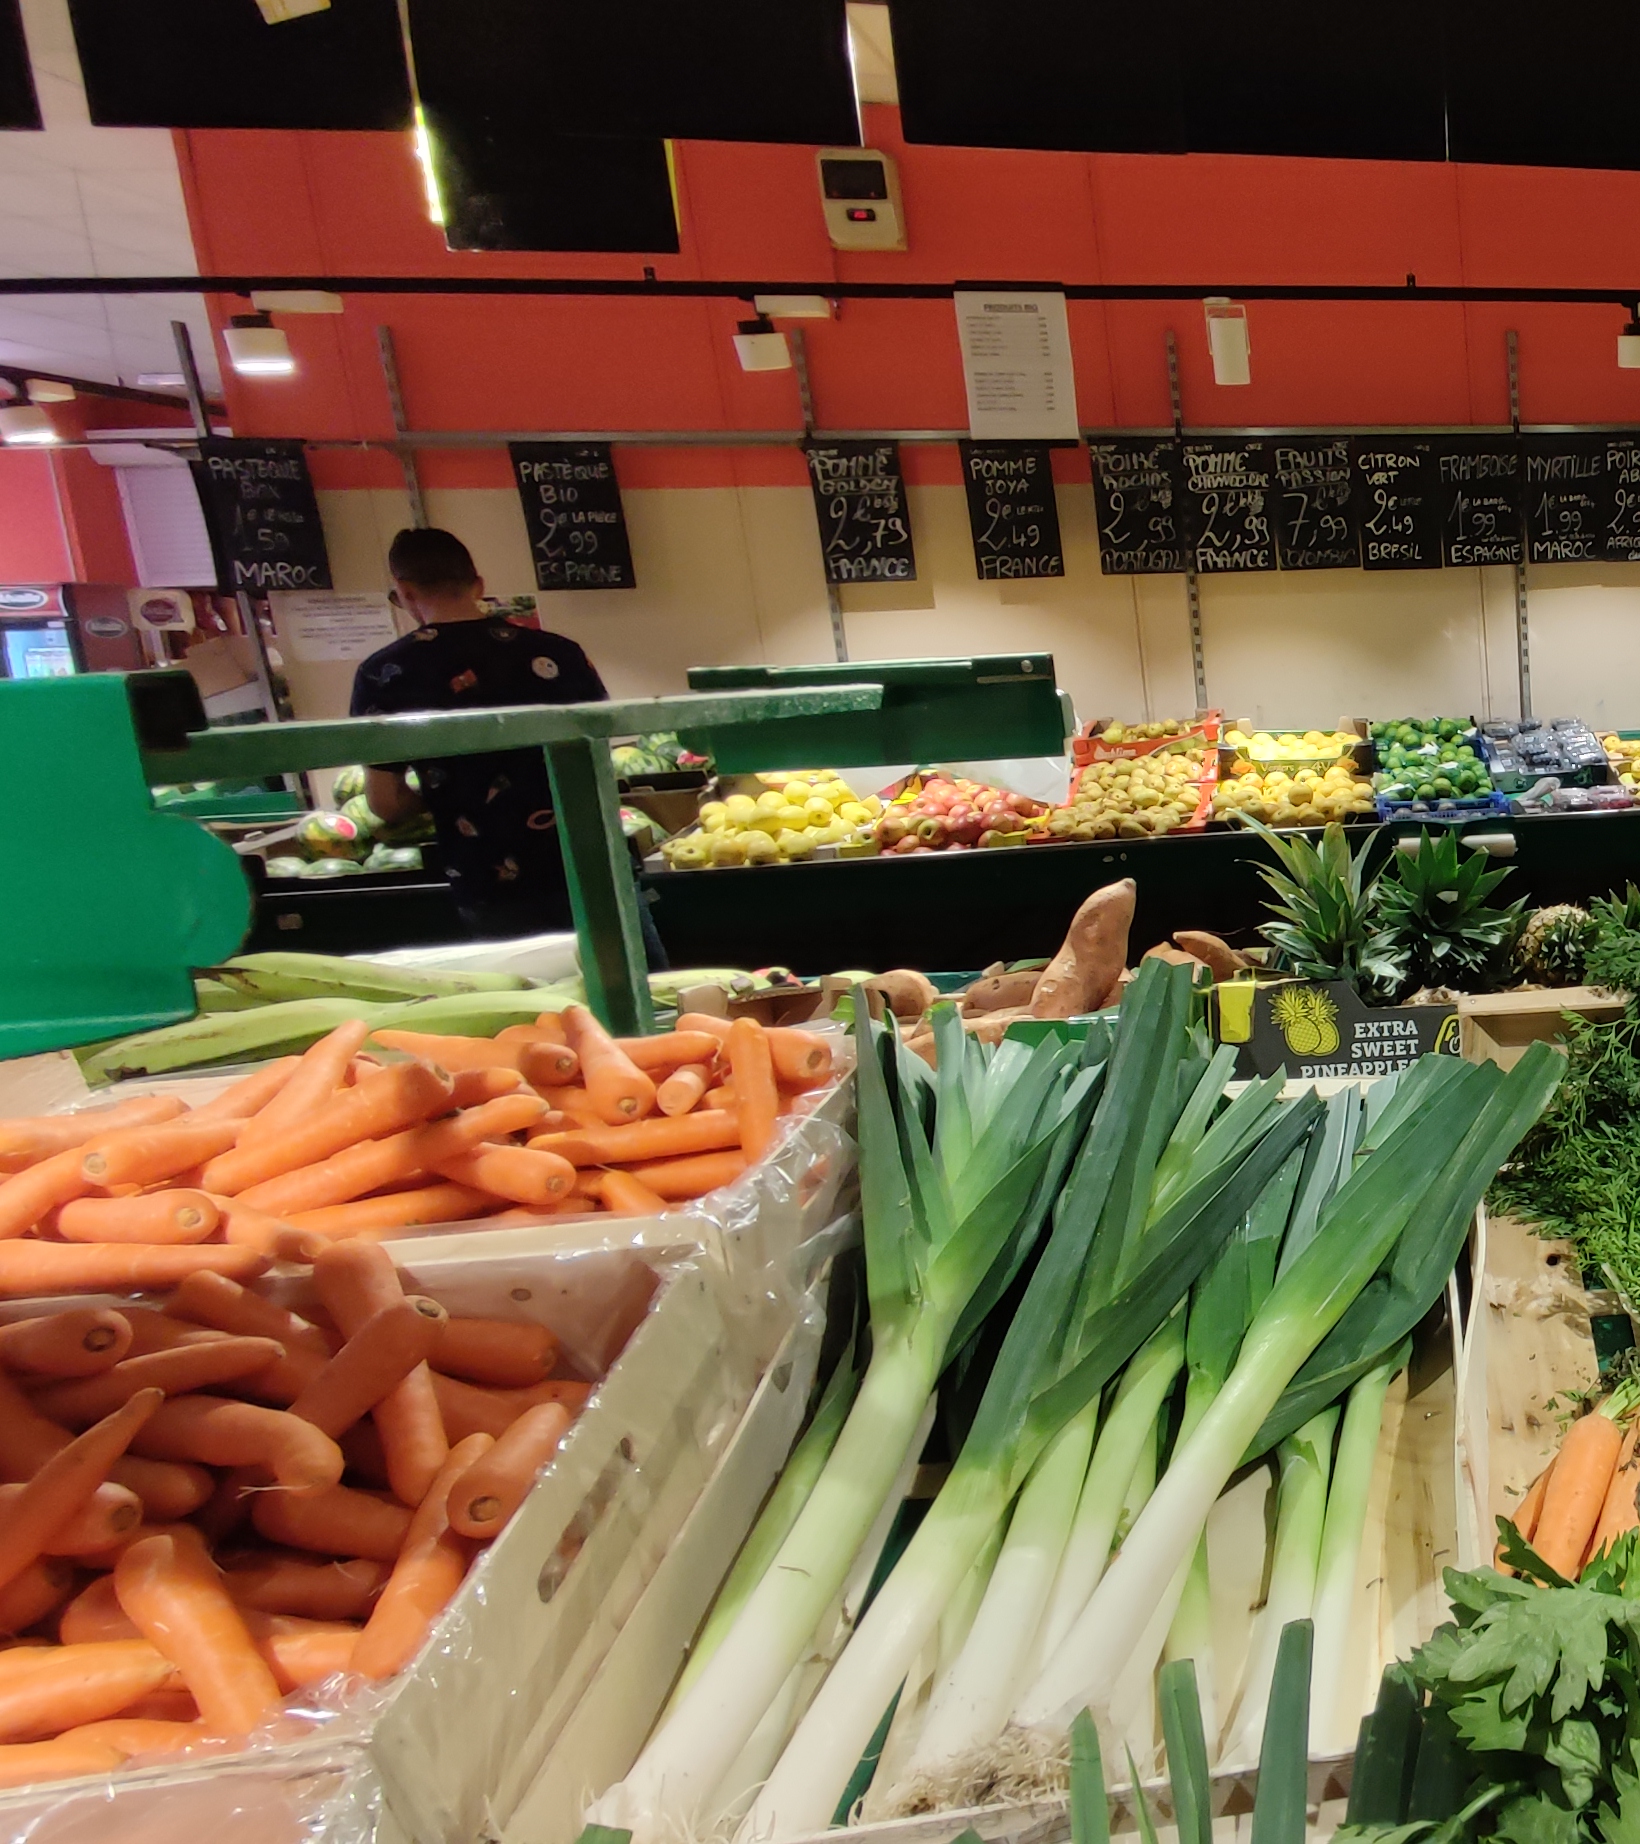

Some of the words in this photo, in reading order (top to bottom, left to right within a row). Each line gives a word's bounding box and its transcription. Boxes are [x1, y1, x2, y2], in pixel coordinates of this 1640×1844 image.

[983, 303, 1022, 312] PRODUITS
[809, 455, 887, 480] POMME
[969, 457, 1037, 480] POMME
[1183, 451, 1250, 477] POMME
[1357, 451, 1420, 470] CITRON
[1527, 454, 1601, 483] MYRTILLE
[985, 478, 1030, 496] JOYA
[1365, 471, 1400, 485] VERT
[1195, 548, 1269, 573] FRANCE
[1368, 542, 1422, 561] BRESIL
[1451, 544, 1521, 564] ESPAGNE
[1534, 541, 1596, 560] MAROC
[233, 560, 322, 588] MAROC
[537, 561, 622, 583] ESPAGNE
[829, 553, 910, 580] FRANCE
[980, 555, 1060, 580] FRANCE
[1353, 1019, 1419, 1039] EXTRA
[1351, 1038, 1420, 1059] SWEET
